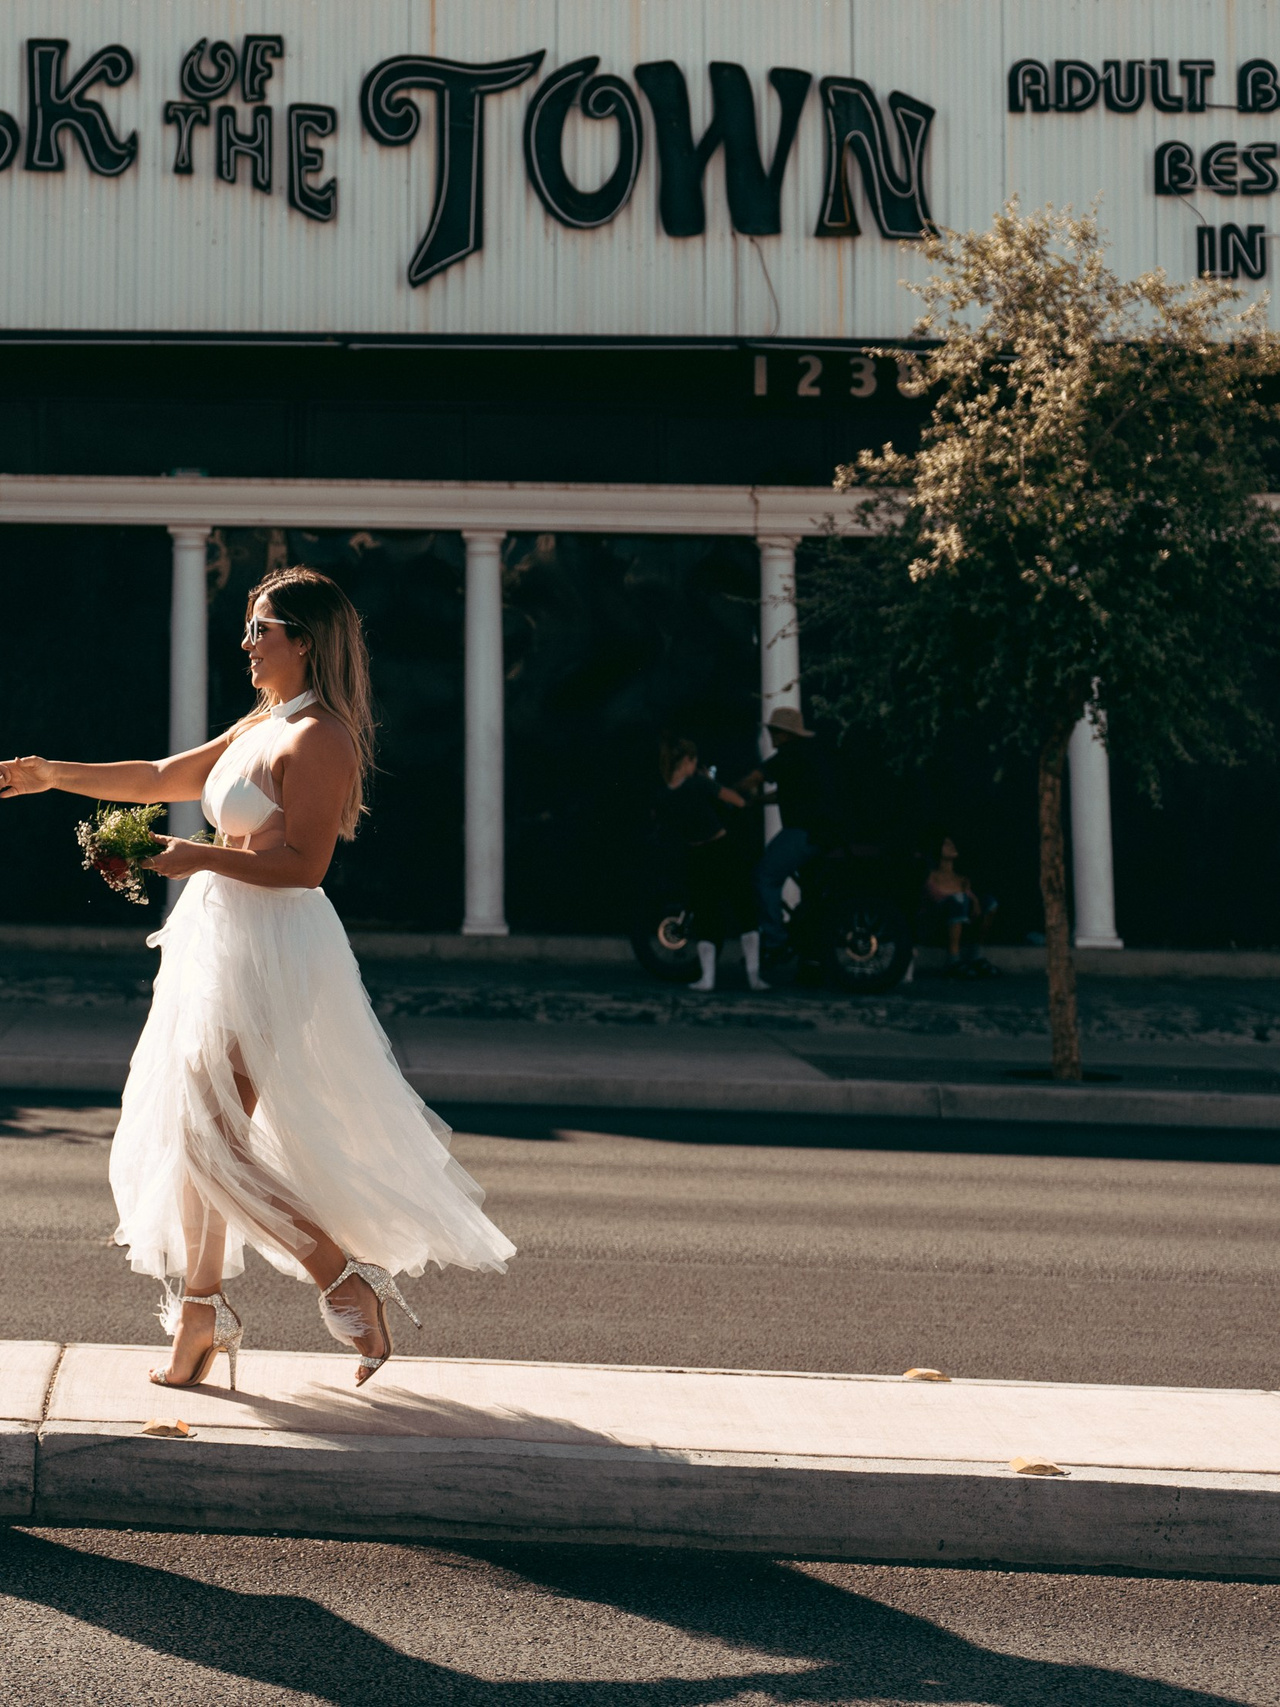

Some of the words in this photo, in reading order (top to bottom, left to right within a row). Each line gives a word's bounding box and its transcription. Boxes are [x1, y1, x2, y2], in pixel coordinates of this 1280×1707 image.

[181, 34, 284, 102] OF
[1008, 59, 1214, 113] ADULT
[165, 101, 337, 221] THE
[360, 50, 938, 287] TOWN
[1196, 223, 1266, 279] IN
